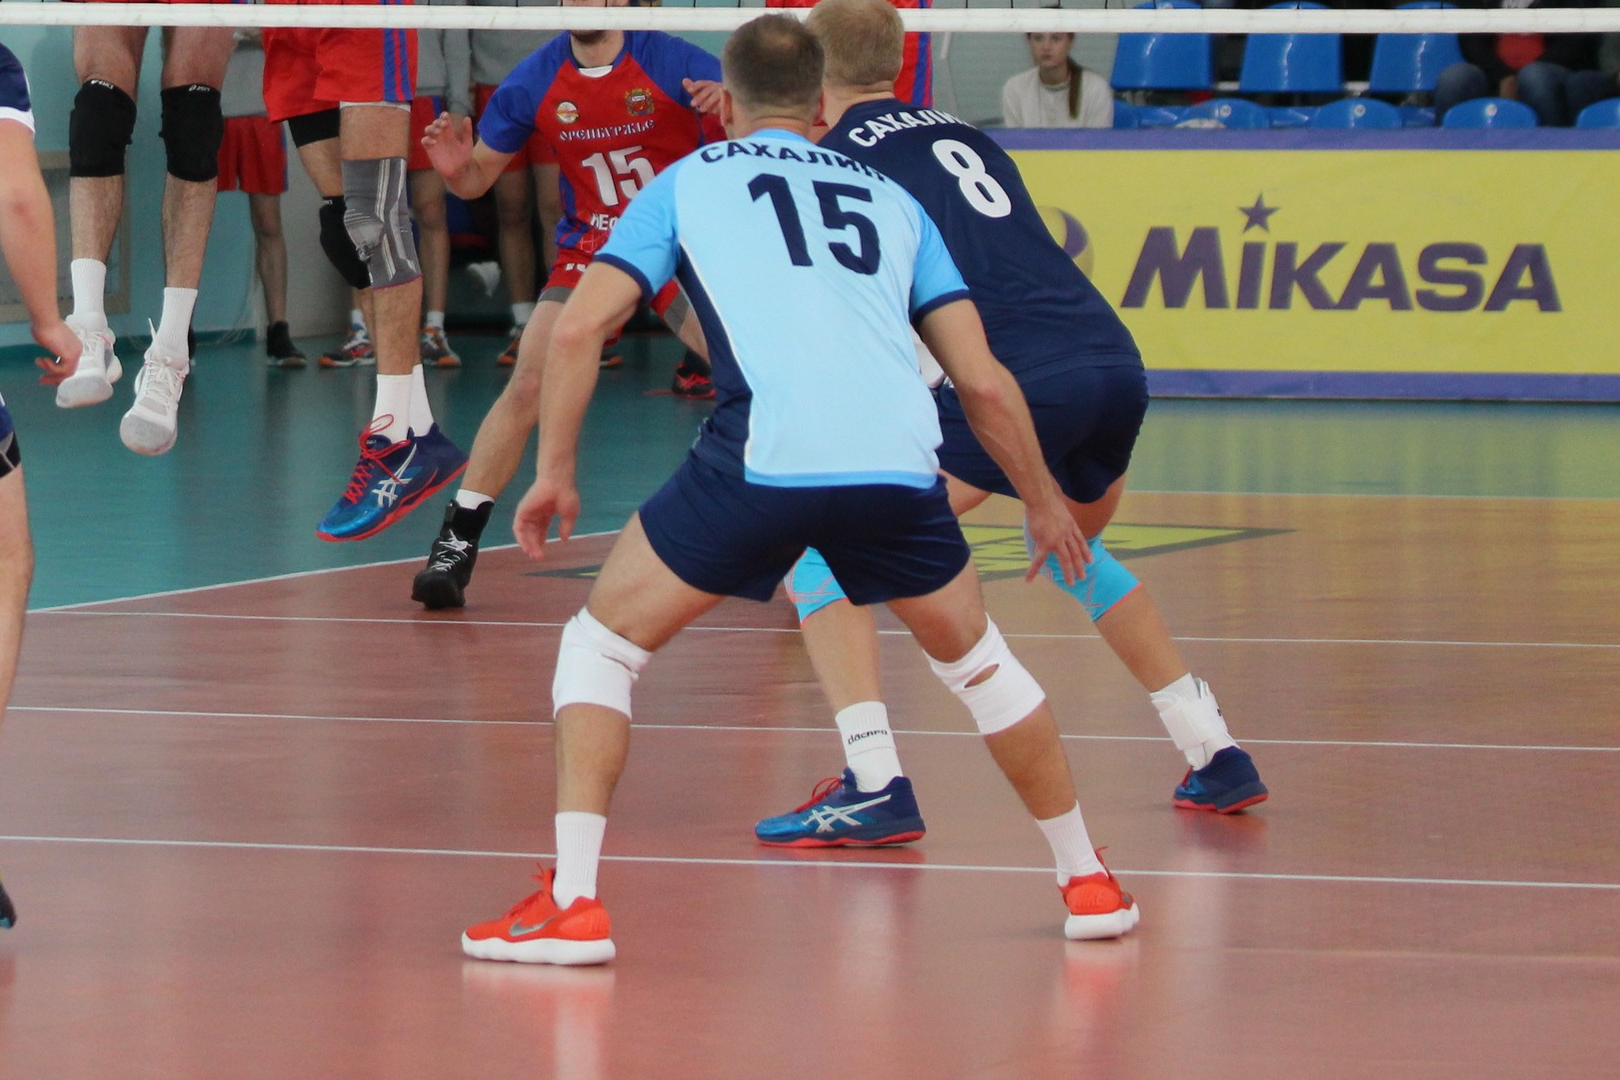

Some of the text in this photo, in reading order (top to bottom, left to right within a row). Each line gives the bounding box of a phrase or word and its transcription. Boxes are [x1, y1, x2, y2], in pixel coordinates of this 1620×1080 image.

[581, 145, 656, 207] 15
[931, 138, 1012, 219] 8
[747, 173, 882, 276] 15
[1120, 224, 1562, 312] MIKASA
